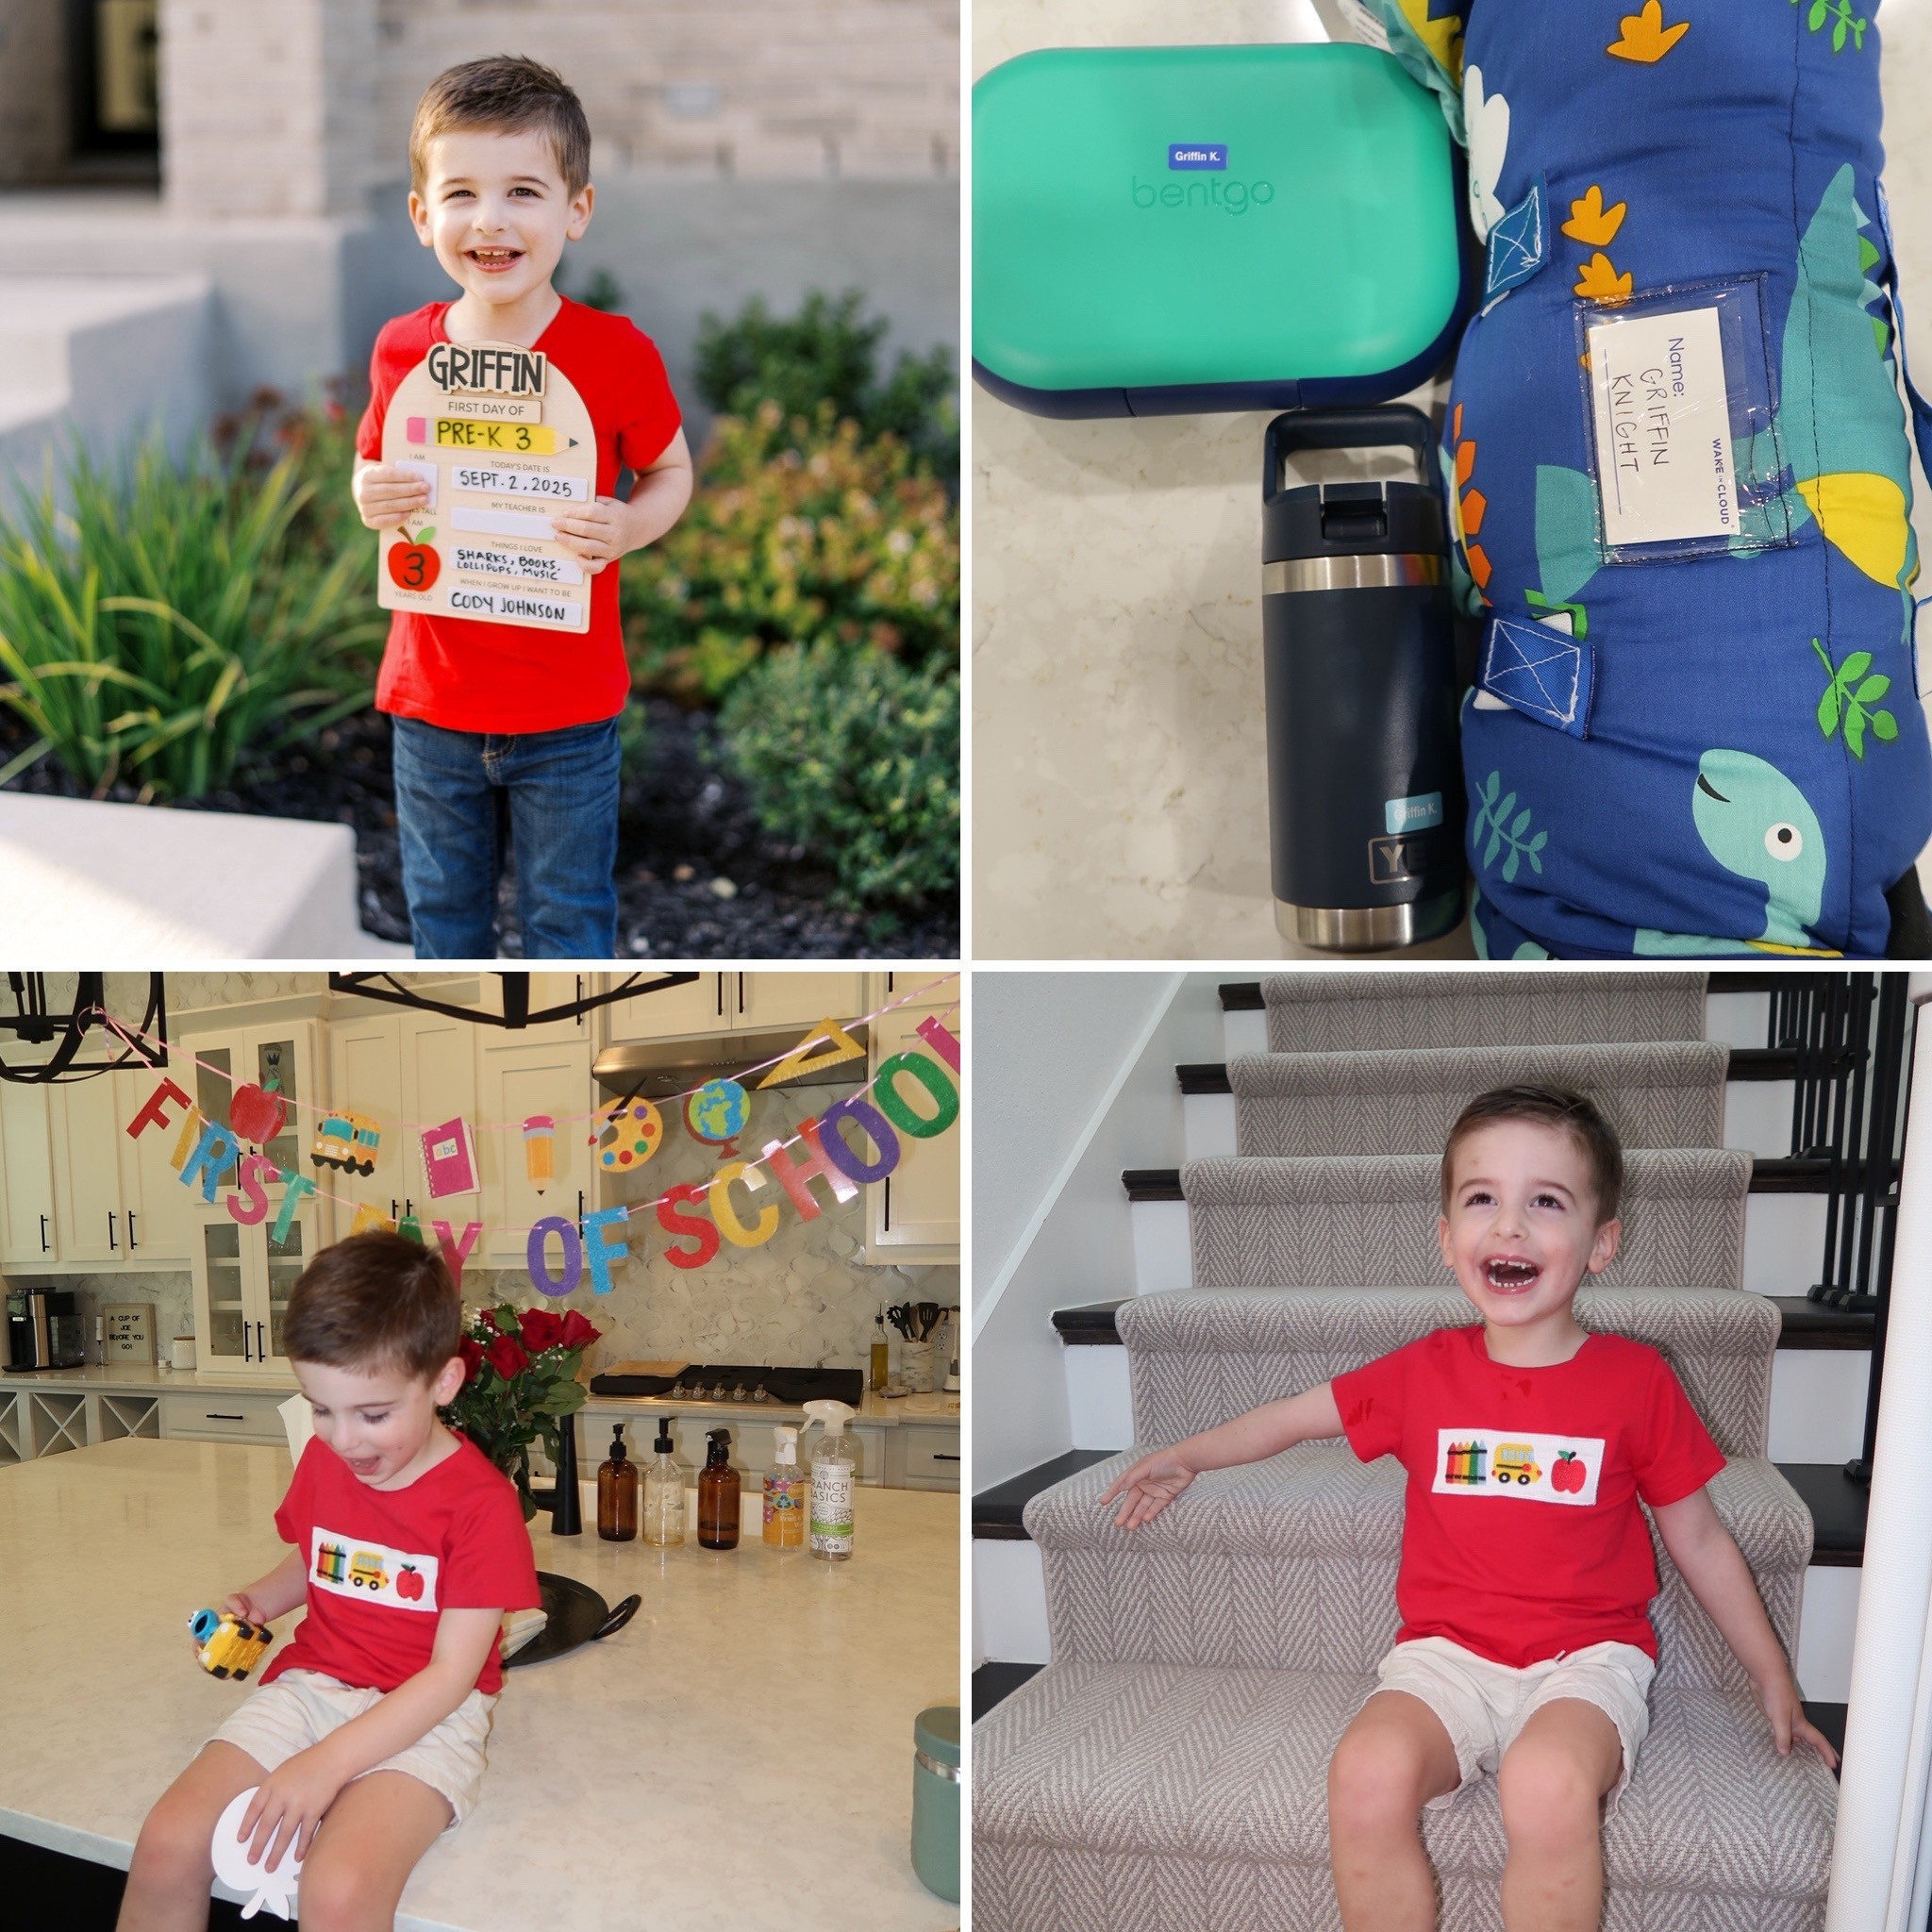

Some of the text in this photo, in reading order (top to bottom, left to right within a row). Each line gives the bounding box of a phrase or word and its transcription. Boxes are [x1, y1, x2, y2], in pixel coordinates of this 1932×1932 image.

[1174, 151, 1220, 161] Griffin K.
[1131, 175, 1274, 216] bentgo
[428, 345, 542, 392] GRIFFIN
[1668, 337, 1685, 397] Name:
[448, 401, 525, 416] FIRST DAY OF
[1640, 368, 1670, 466] GRIFFIN
[437, 421, 531, 450] PRE-K 3
[1611, 374, 1640, 473] KNIGHT
[491, 460, 521, 471] TODAY'S
[523, 464, 541, 473] DATE
[1712, 438, 1724, 474] WAKE
[531, 477, 573, 497] 2025
[505, 503, 537, 512] TEACHER
[1717, 484, 1730, 525] CLOUD
[457, 549, 515, 566] SHARKS,
[491, 541, 519, 550] THINGS
[524, 545, 543, 554] LOVE
[404, 552, 425, 587] 3
[522, 568, 558, 581] MUSIC
[394, 591, 433, 601] YEARS OLD
[460, 578, 482, 587] WHEN
[487, 580, 509, 590] GROW
[526, 586, 549, 594] WANT
[561, 590, 572, 598] BE
[451, 591, 565, 621] CODY JOHNSON
[126, 1076, 318, 1246] FIRST
[436, 1144, 457, 1158] abc
[526, 1206, 630, 1298] OF
[811, 1489, 846, 1503] ASICS
